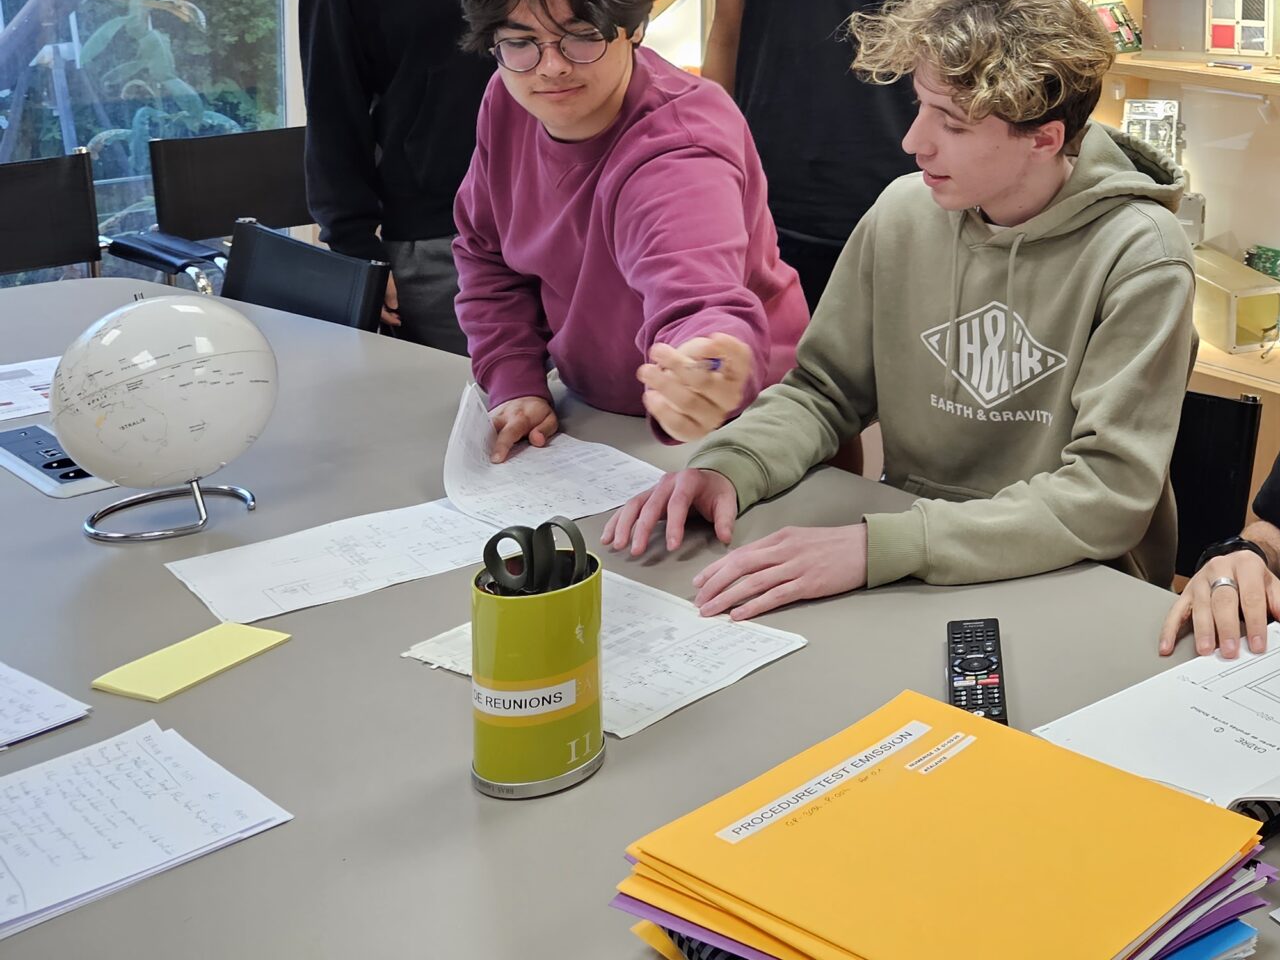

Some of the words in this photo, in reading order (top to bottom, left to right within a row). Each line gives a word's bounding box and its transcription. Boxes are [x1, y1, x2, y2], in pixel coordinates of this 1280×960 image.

[930, 393, 973, 419] EARTH
[976, 409, 987, 422] &
[486, 691, 563, 710] REUNIONS
[731, 787, 818, 836] PROCEDURE
[815, 766, 851, 789] TEST
[850, 731, 913, 769] EMISSION
